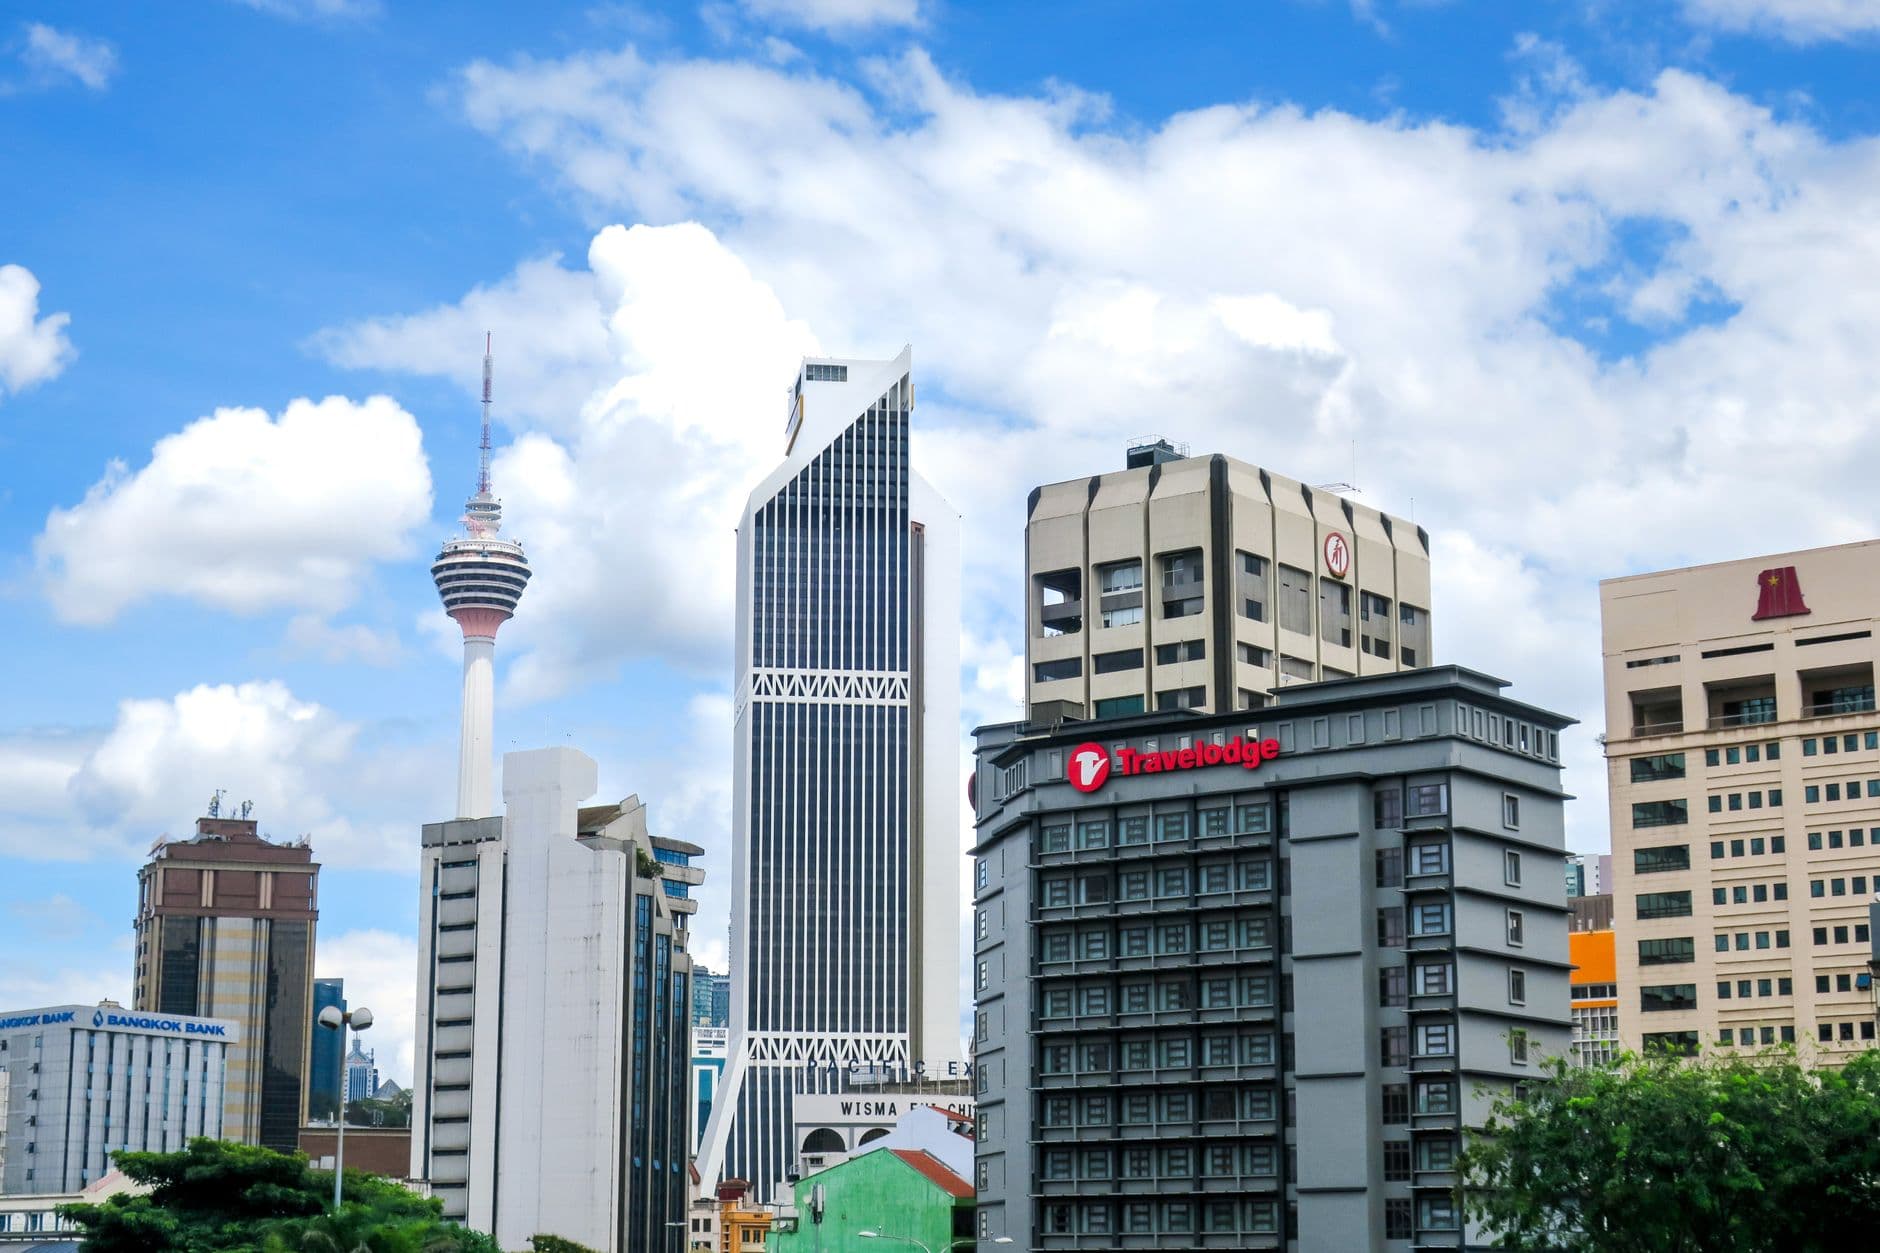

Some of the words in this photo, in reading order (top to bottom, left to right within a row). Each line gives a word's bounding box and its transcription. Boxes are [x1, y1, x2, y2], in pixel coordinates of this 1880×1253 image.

[1116, 736, 1280, 776] Travelodge
[42, 1012, 75, 1025] BANK
[107, 1014, 182, 1032] BANGKOK
[185, 1022, 225, 1036] BANK
[808, 1059, 926, 1076] PACIFIC
[841, 1101, 897, 1116] WISMA
[948, 1103, 977, 1117] CHI
